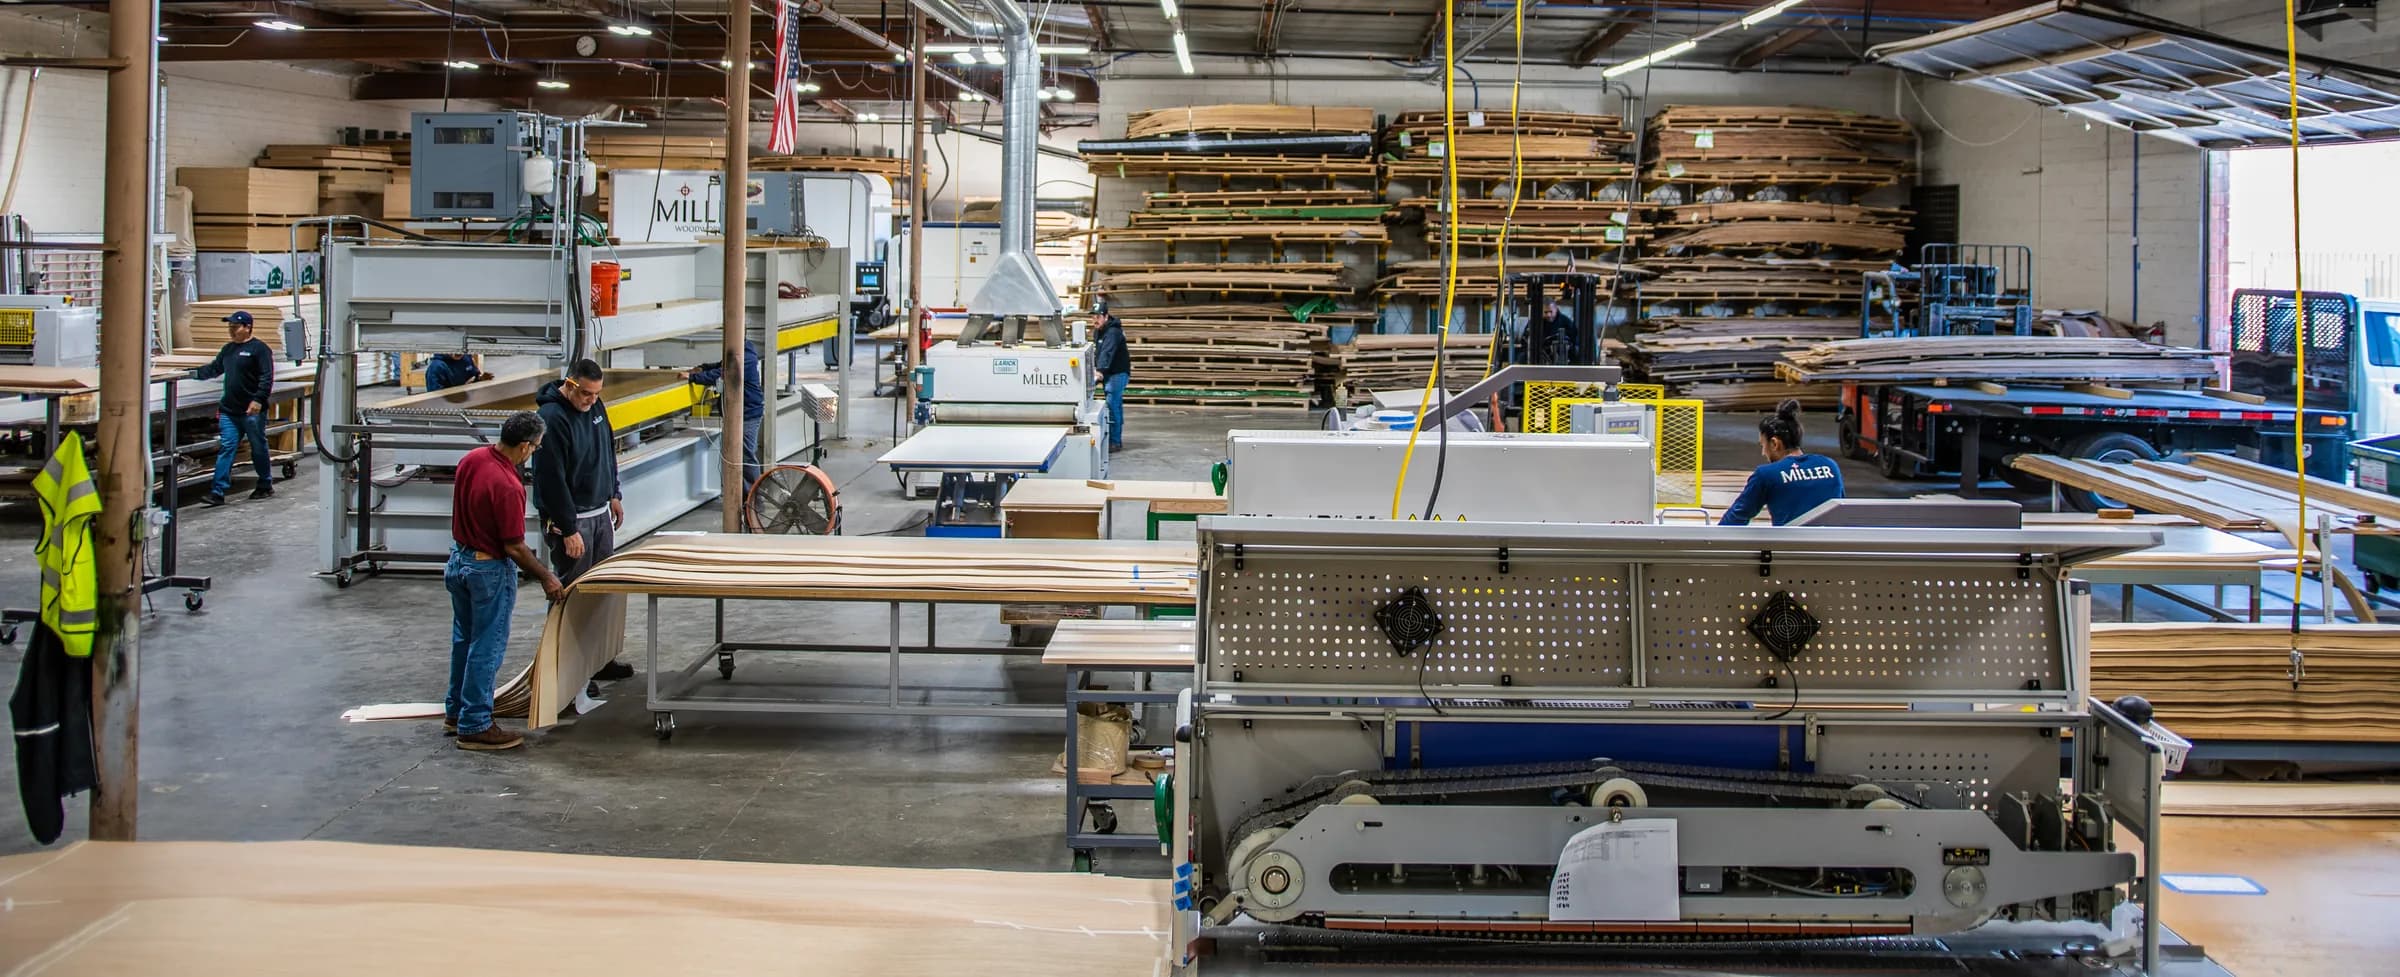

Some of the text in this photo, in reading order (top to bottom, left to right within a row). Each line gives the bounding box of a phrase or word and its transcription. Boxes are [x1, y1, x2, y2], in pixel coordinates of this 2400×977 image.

[657, 199, 721, 223] MILL
[1022, 373, 1069, 386] MILLER
[1780, 465, 1835, 484] MILLER
